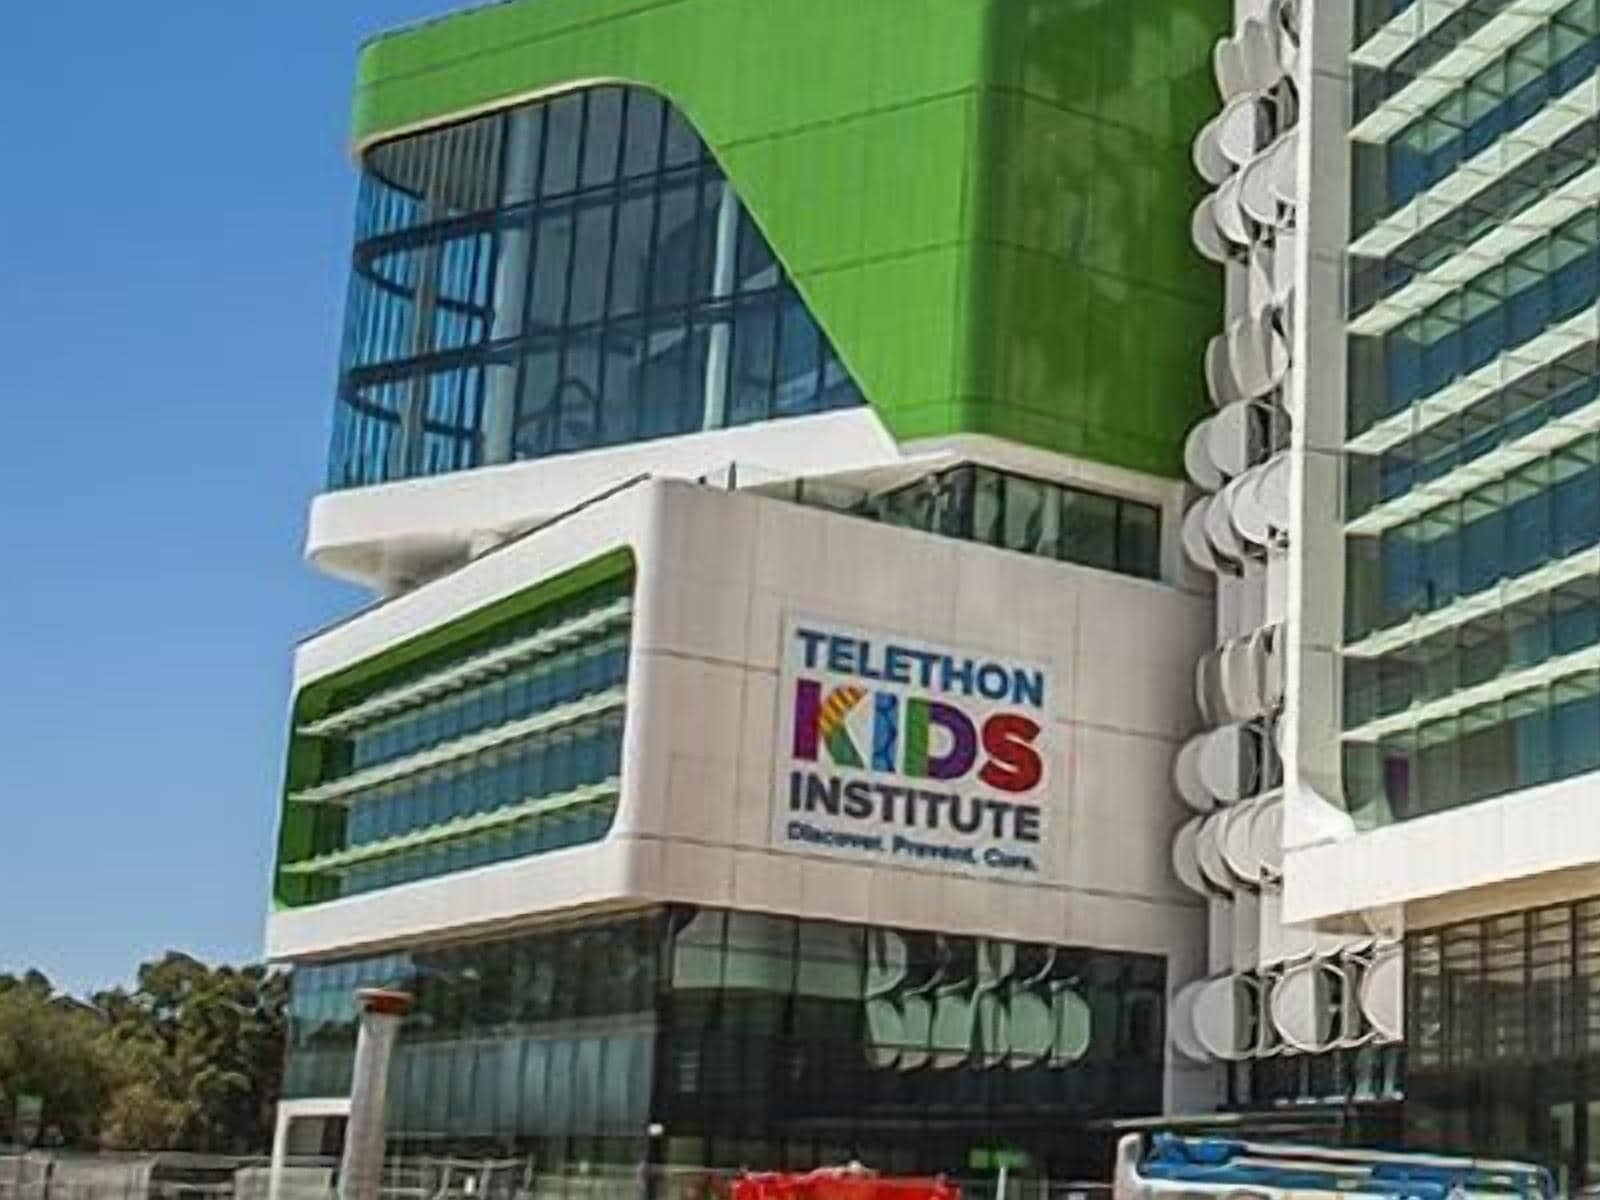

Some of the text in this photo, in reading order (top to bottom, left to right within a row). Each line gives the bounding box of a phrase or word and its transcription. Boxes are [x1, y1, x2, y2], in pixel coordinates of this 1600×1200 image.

[796, 628, 1044, 707] TELETHON
[792, 678, 1043, 794] KIDS
[789, 771, 1041, 843] INSTITUTE
